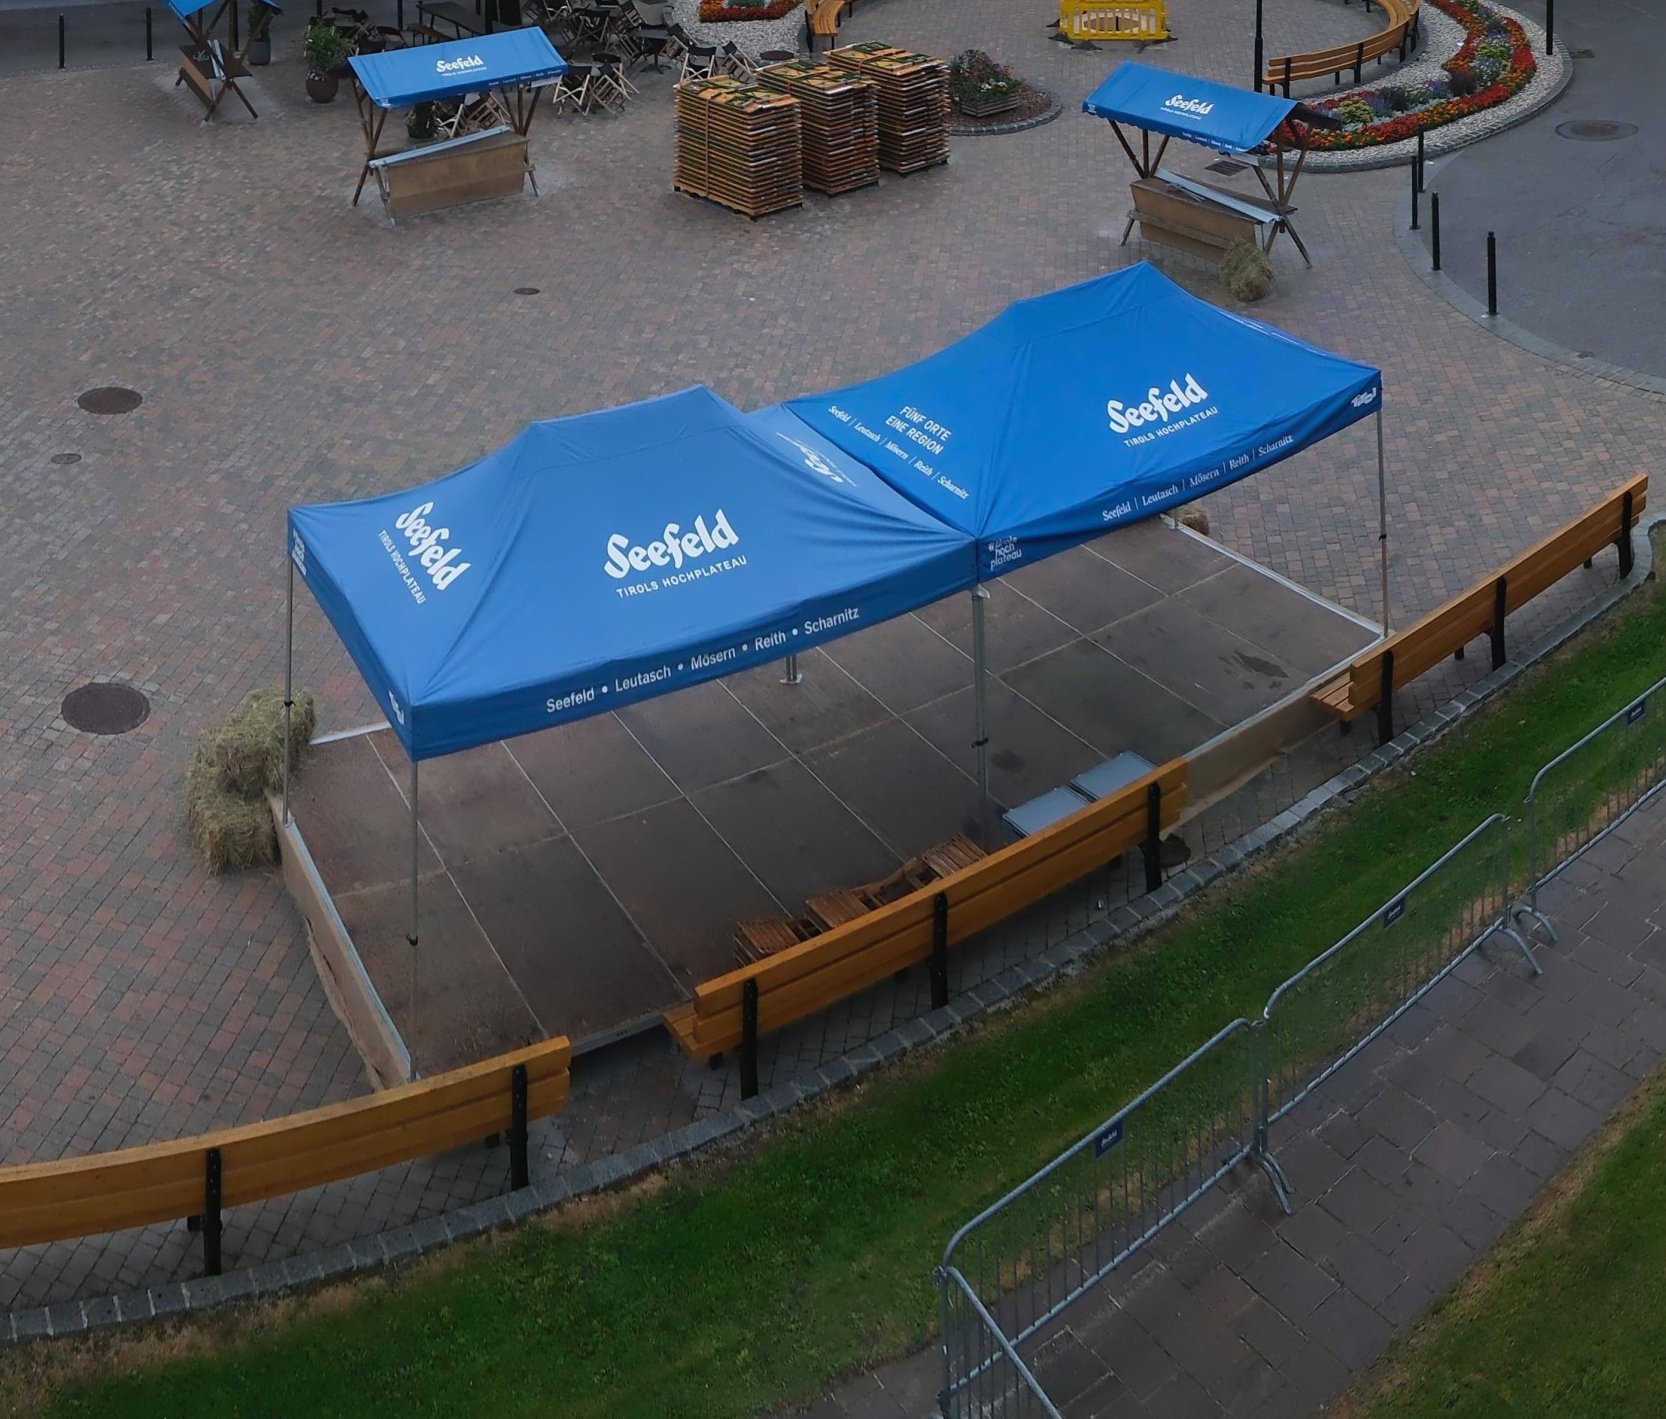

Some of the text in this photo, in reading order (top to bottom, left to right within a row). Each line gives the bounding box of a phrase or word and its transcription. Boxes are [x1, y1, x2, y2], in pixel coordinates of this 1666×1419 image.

[436, 55, 484, 72] Seefeld
[1164, 93, 1216, 116] Seefeld
[900, 406, 952, 441] FÜNF ORTE
[1107, 372, 1208, 433] Seefeld
[885, 415, 944, 455] EINE REGION
[1123, 406, 1218, 448] TIROLS HOCHPLATEAU
[1102, 434, 1293, 522] Seefeld Leutasch Mösern Reith Scharnitz
[395, 501, 471, 591] Seefeld
[603, 508, 739, 579] Seefeld
[990, 550, 1022, 571] plateau
[995, 542, 1015, 560] hoch
[378, 529, 426, 605] TIROLS HOCHPLATEAU
[616, 555, 747, 598] TIROLS HOCHPLATEAU
[546, 606, 860, 713] Seefeld Leutasch Mösern Reith Scharnitz
